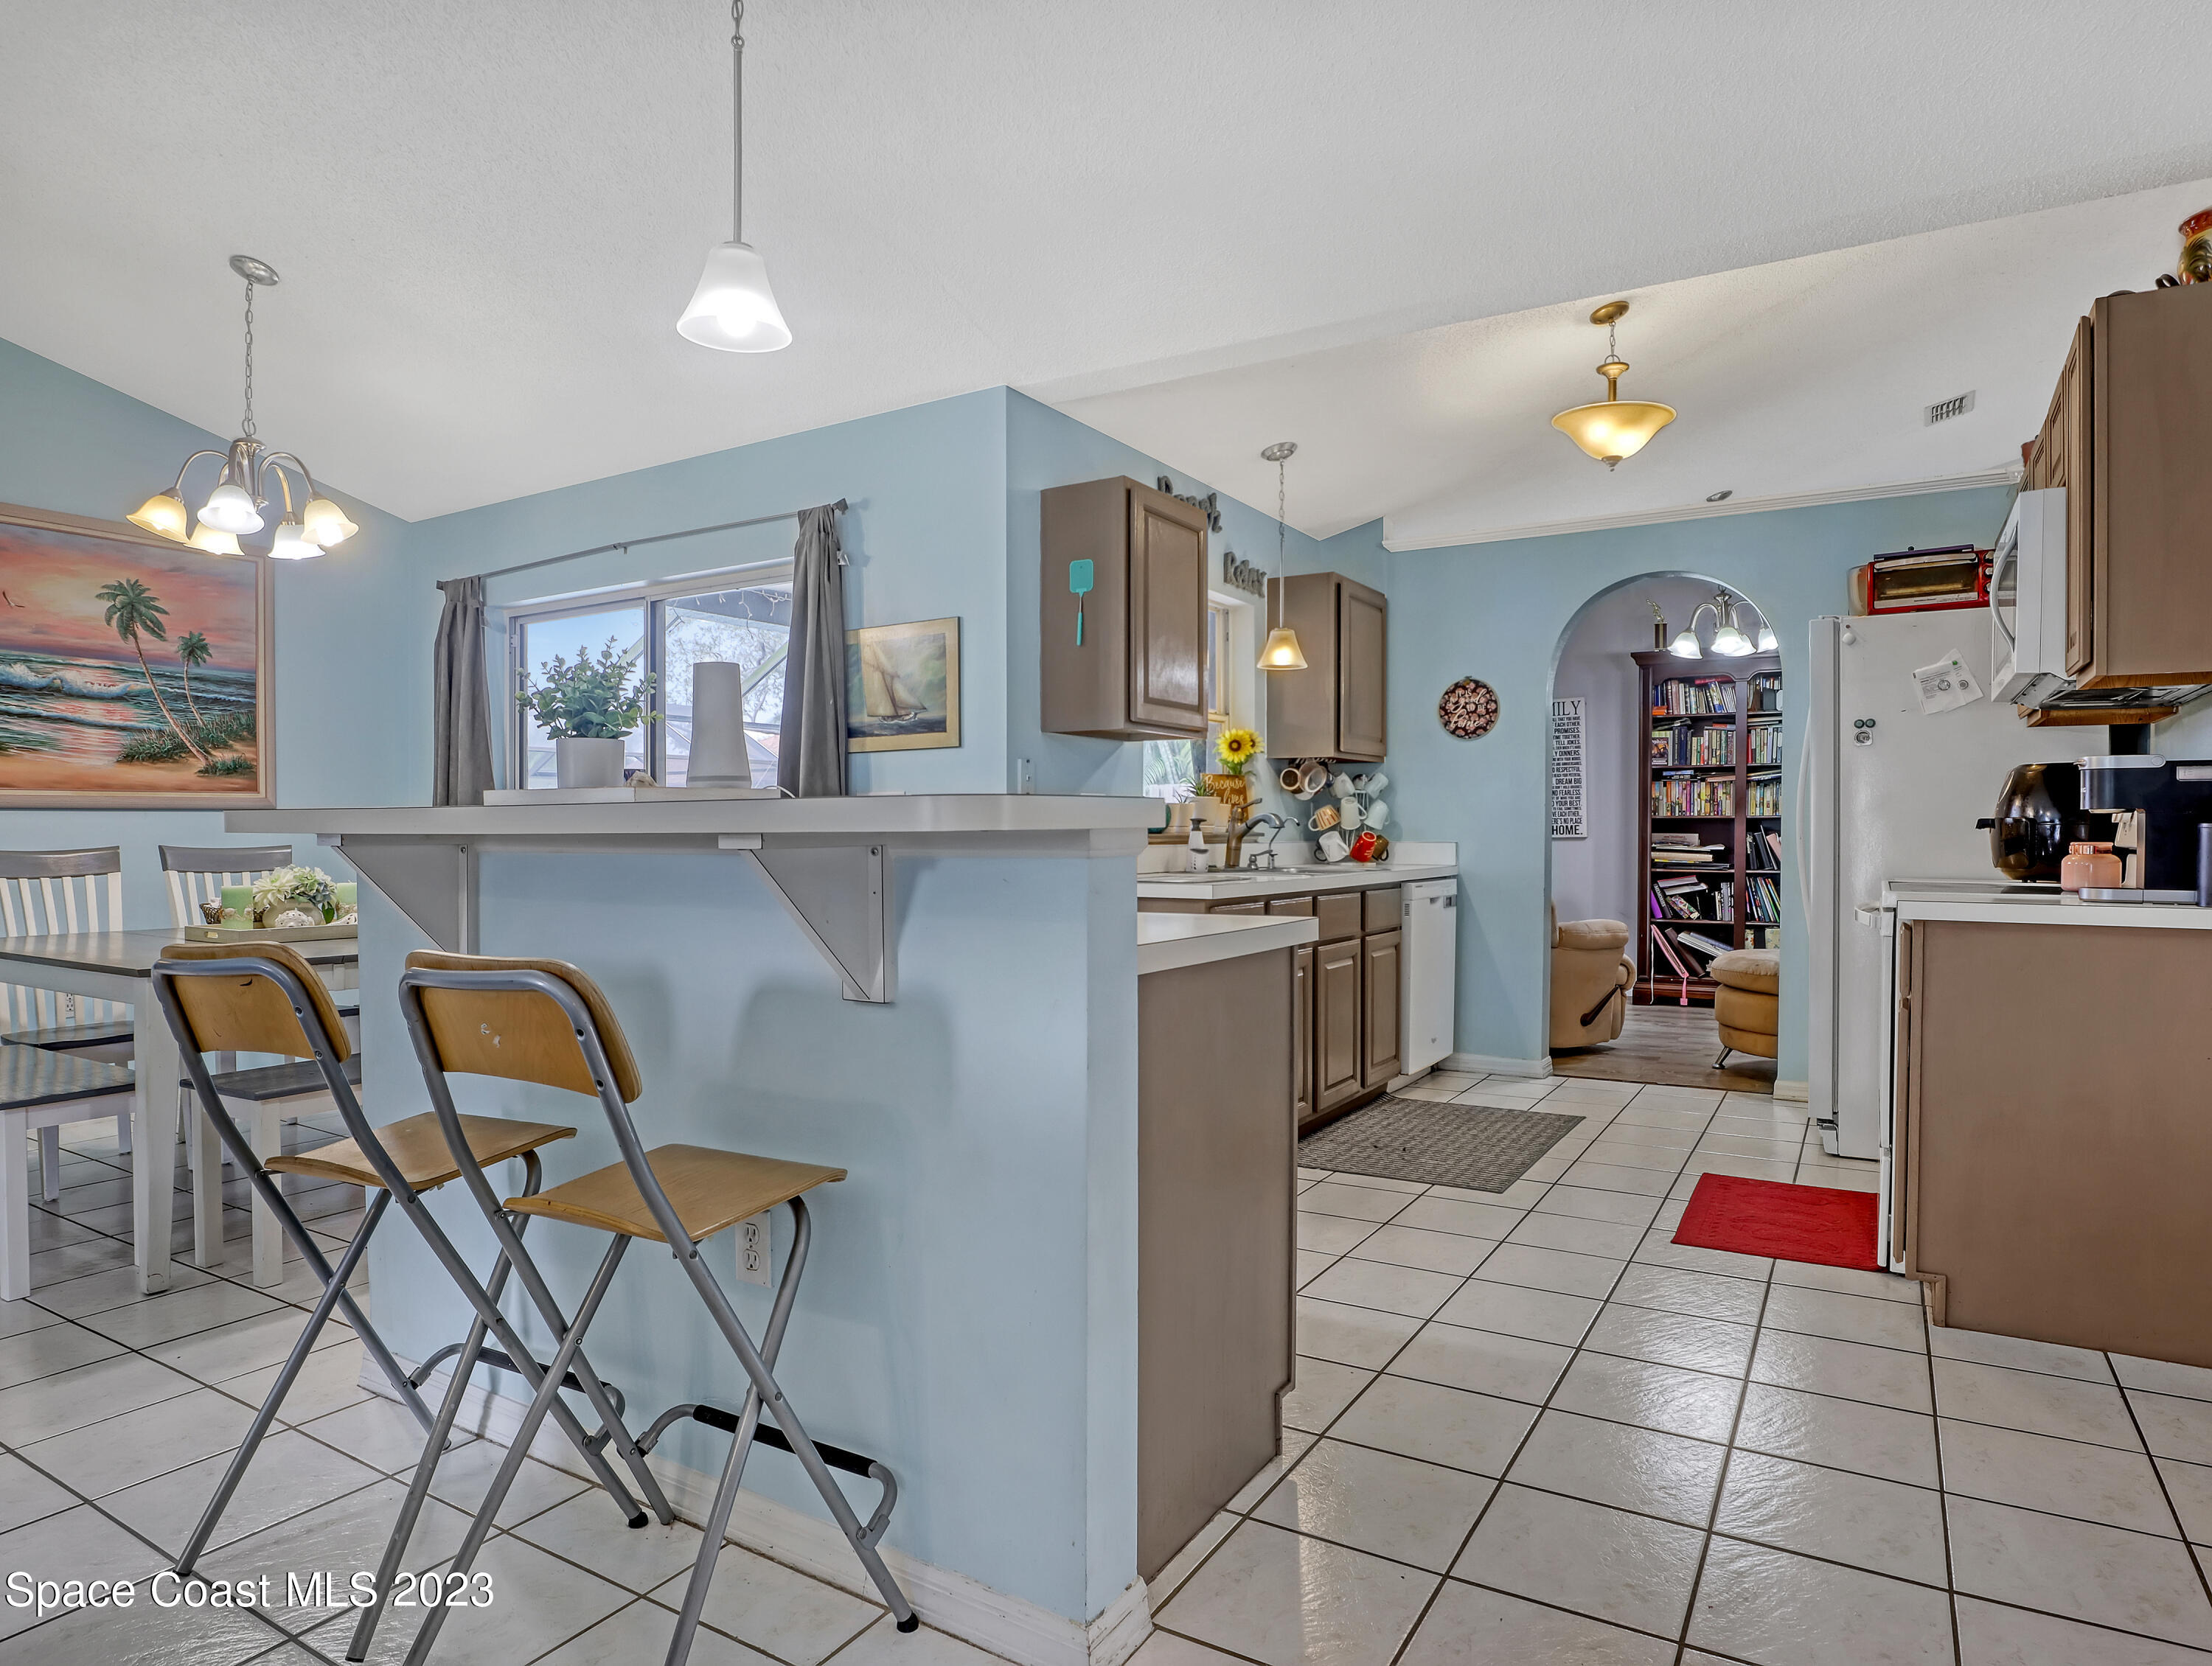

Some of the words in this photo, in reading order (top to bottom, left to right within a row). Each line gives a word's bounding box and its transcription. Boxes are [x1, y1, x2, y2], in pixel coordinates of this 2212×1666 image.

[1553, 700, 1582, 716] ILY
[1204, 774, 1244, 792] Because
[1552, 825, 1583, 834] HOME.
